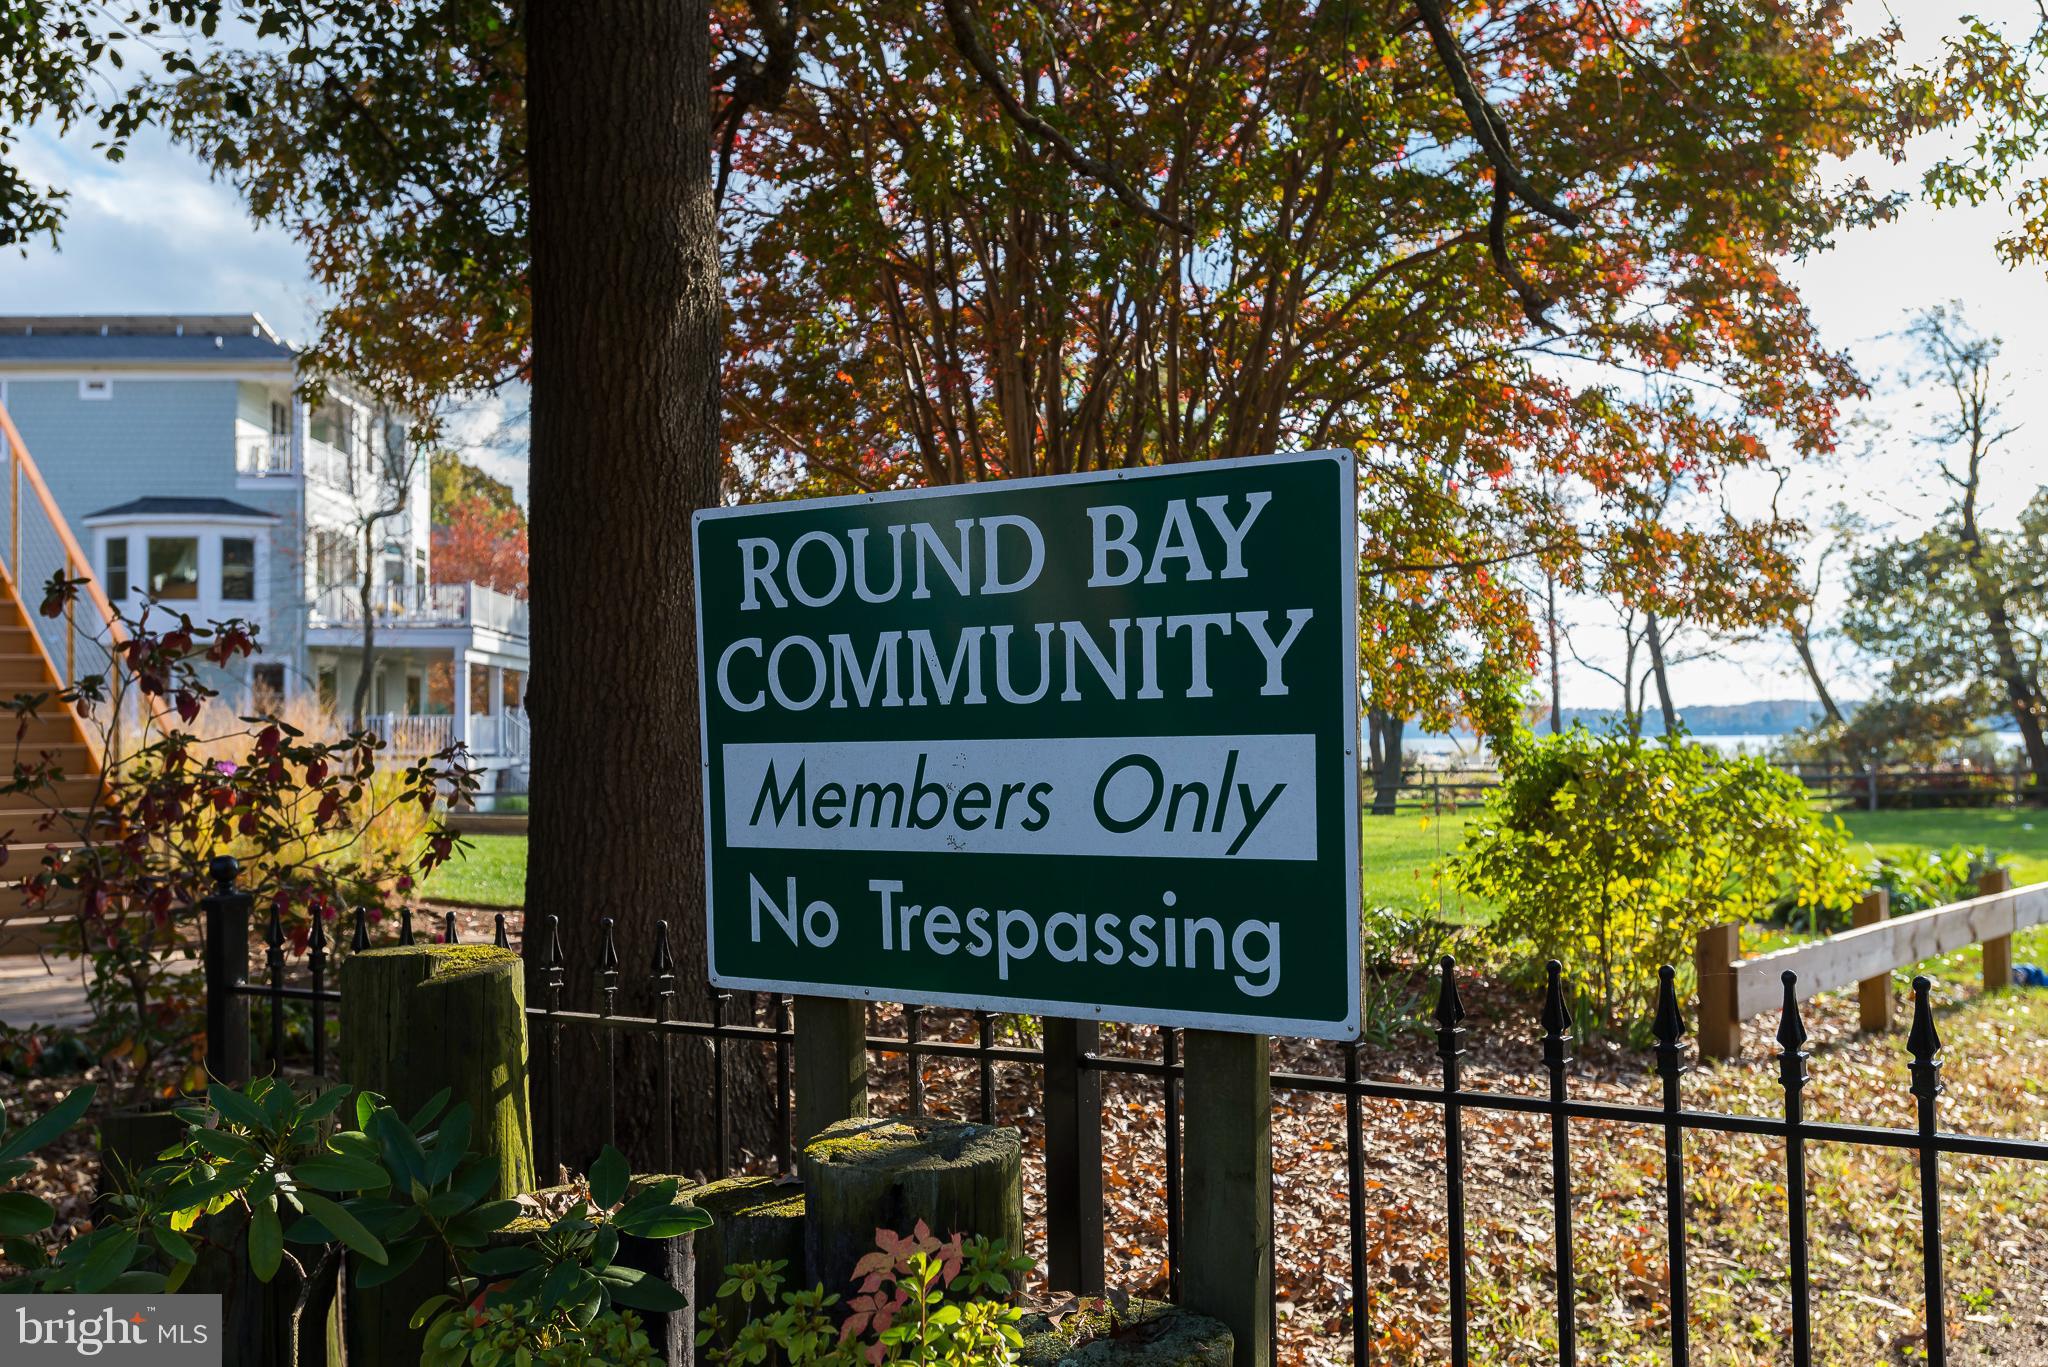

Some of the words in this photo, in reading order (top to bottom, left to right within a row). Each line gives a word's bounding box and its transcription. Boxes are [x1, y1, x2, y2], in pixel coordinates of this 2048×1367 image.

[737, 514, 1046, 611] ROUND
[1086, 491, 1272, 588] BAY
[716, 608, 1314, 712] COMMUNITY
[748, 752, 1053, 832] Members
[1093, 749, 1288, 857] Only
[749, 873, 839, 948] No
[868, 879, 1281, 997] Trespassing
